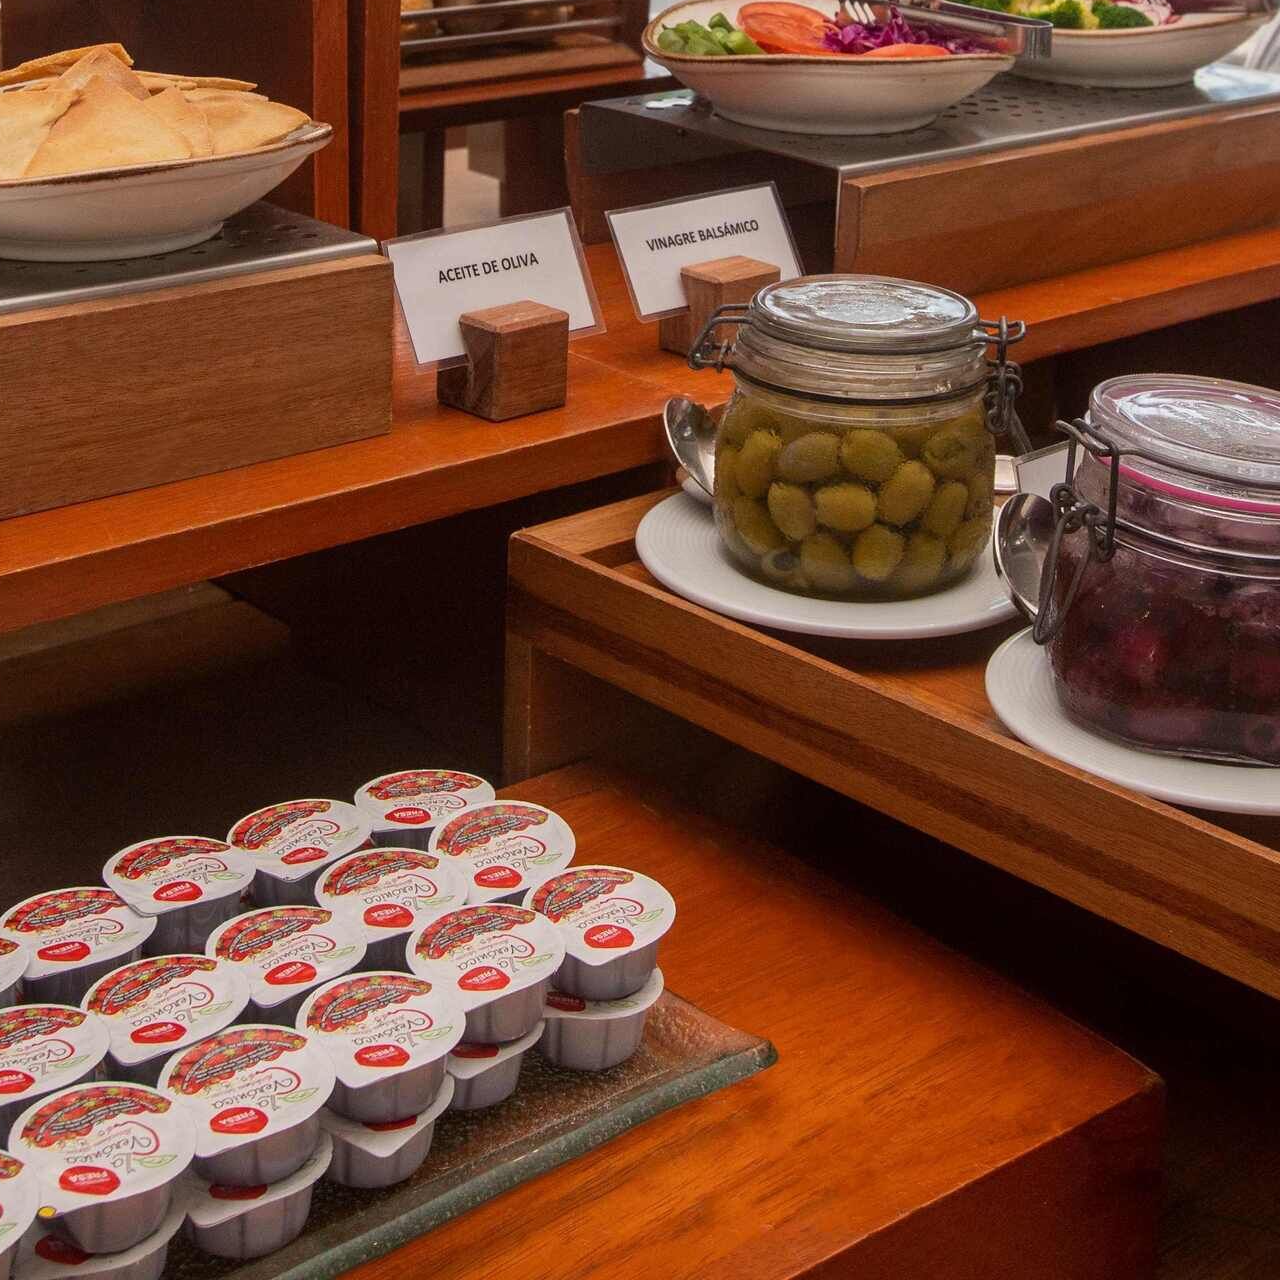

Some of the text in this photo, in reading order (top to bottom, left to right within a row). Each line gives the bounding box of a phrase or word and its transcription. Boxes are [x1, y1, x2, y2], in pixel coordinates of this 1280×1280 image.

[646, 217, 760, 253] VINAGRE BALSÁMICO
[437, 251, 539, 285] ACEITE DE OLIVA
